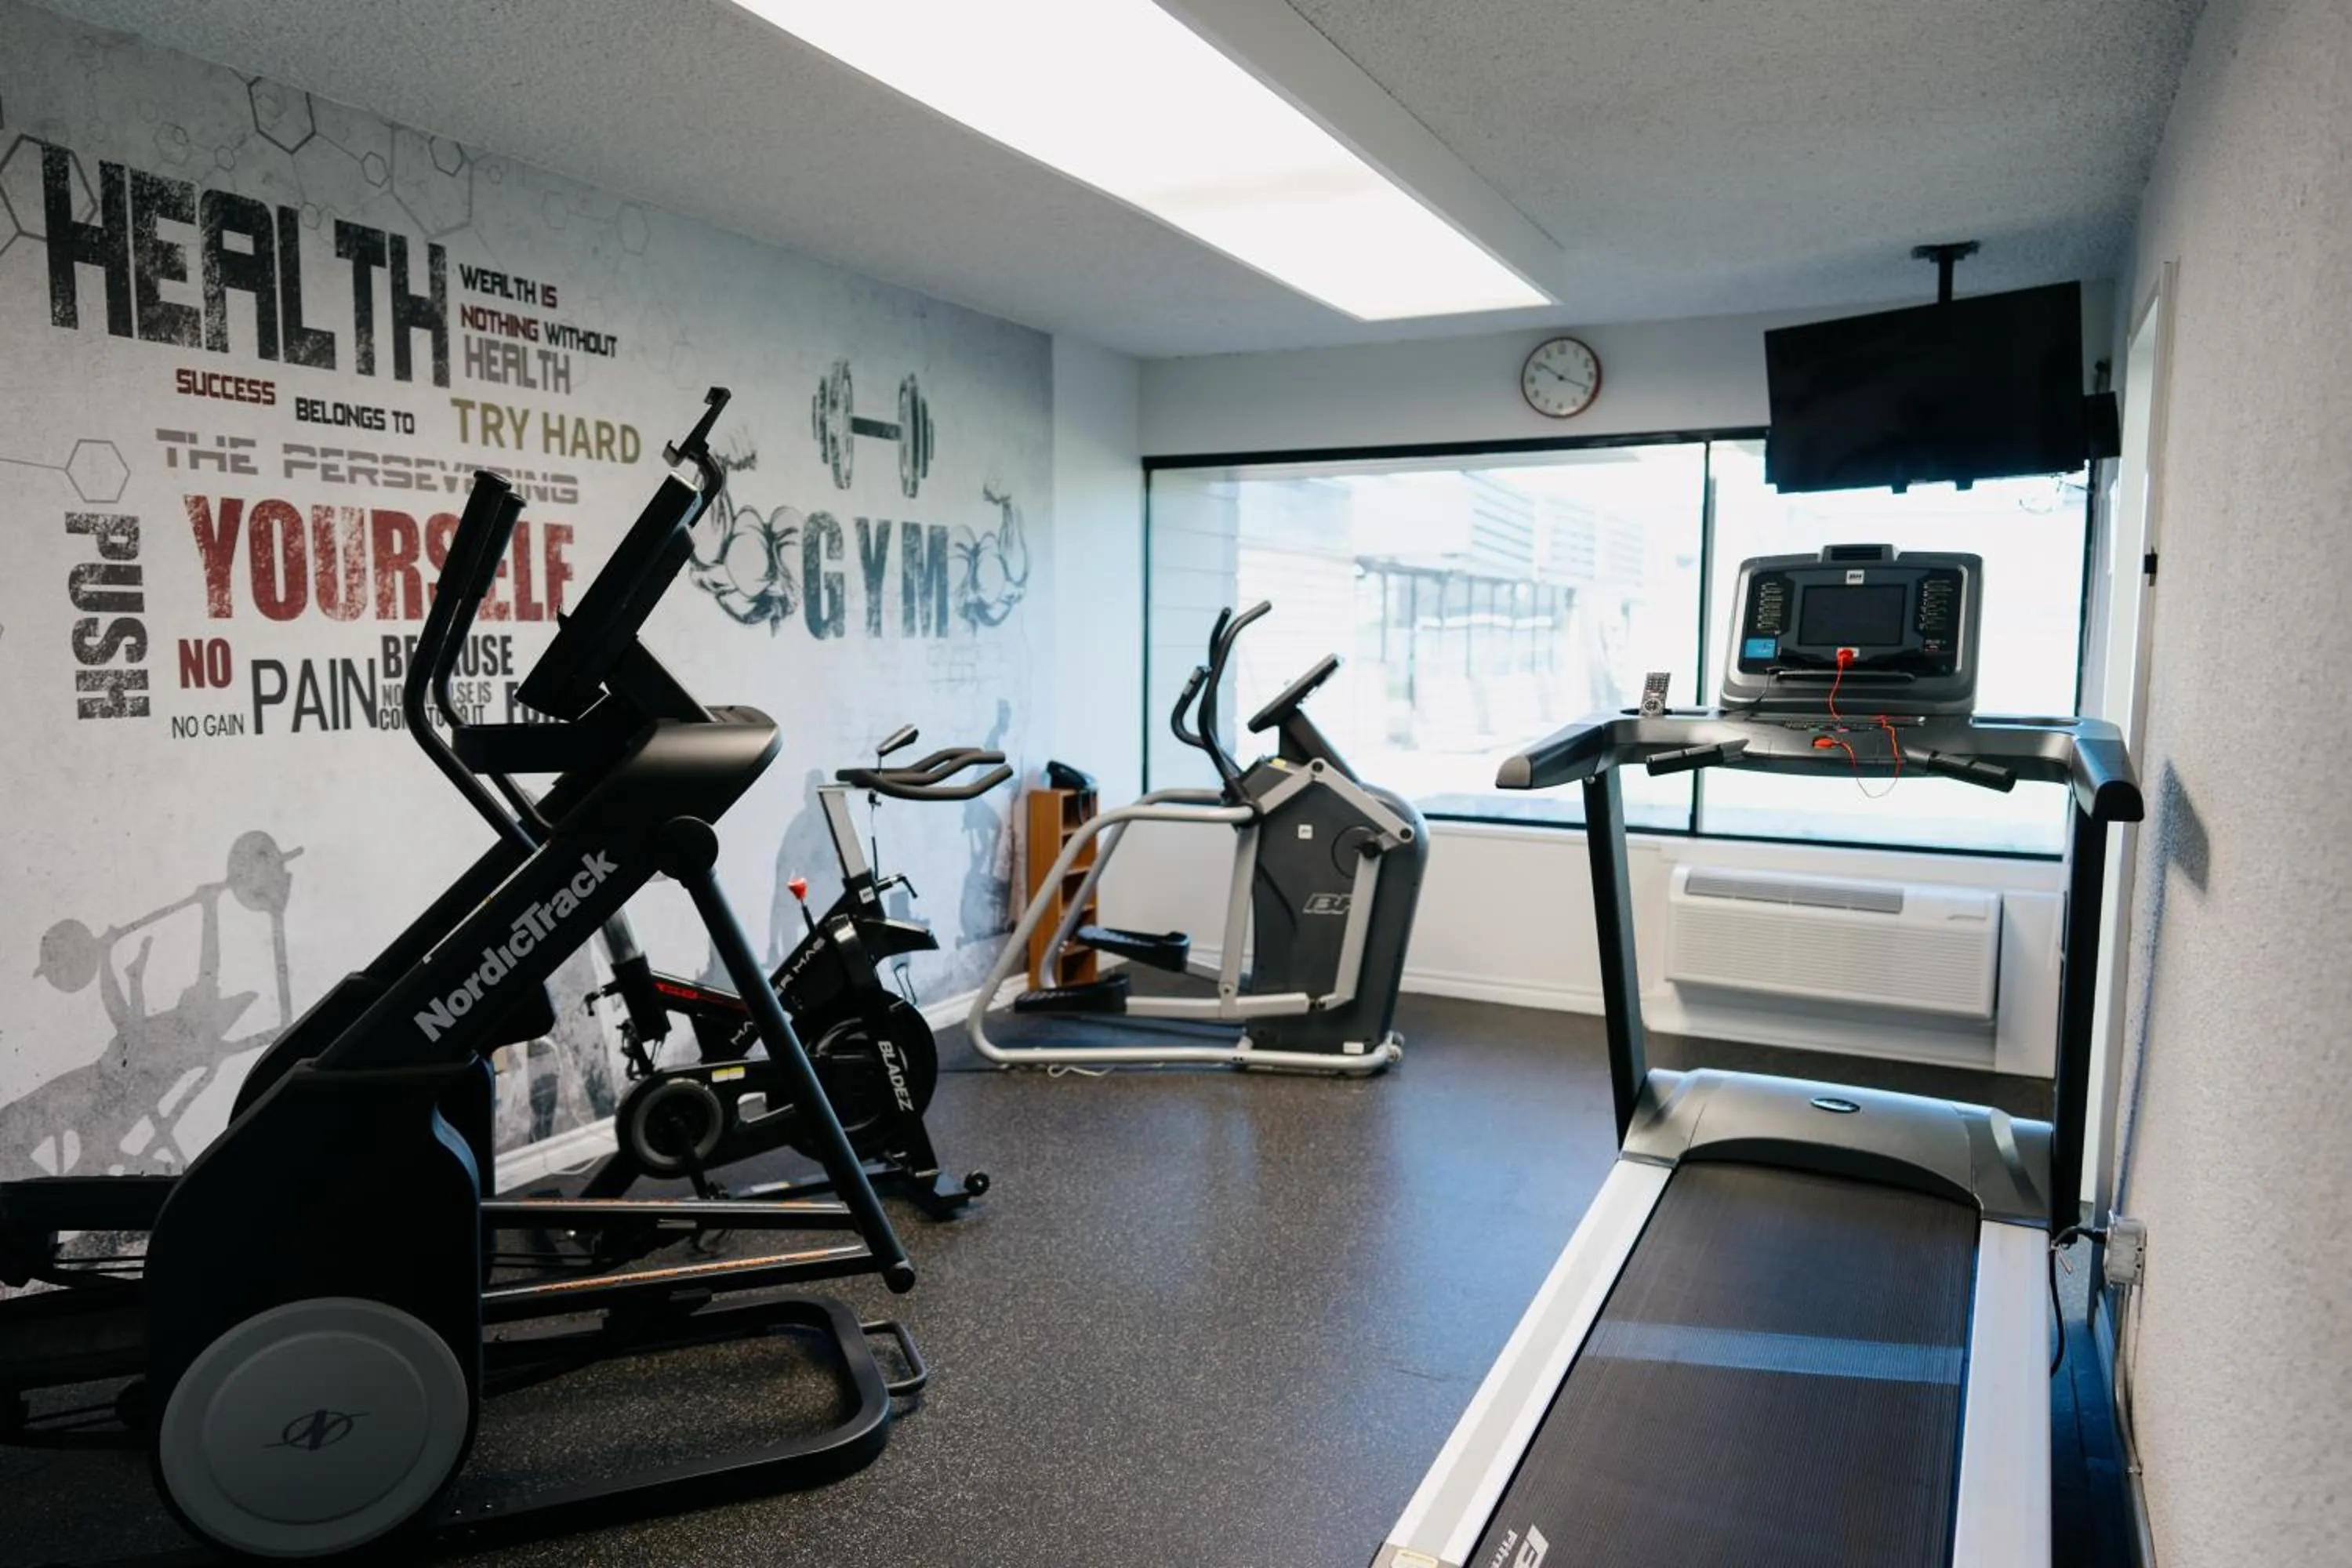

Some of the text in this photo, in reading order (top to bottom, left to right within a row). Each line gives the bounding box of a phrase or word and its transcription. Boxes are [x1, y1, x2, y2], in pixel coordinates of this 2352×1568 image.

[42, 144, 450, 388] HEALTH
[459, 263, 557, 308] WEALTH IS
[460, 303, 617, 358] NOTHING WITHOUT
[464, 334, 571, 395] HEALTH
[176, 368, 415, 434] SUCCESS BELONGS TO
[450, 397, 641, 464] TRY HARD
[157, 429, 259, 475] THE
[801, 510, 949, 641] GYM
[64, 511, 151, 720] PUSH
[178, 637, 232, 689] NO
[250, 658, 377, 735] PAIN
[381, 633, 514, 679] BEUSE
[172, 714, 245, 739] NO GAIN
[413, 849, 619, 1043] NordicTrack
[878, 1040, 914, 1112] BLADEZ
